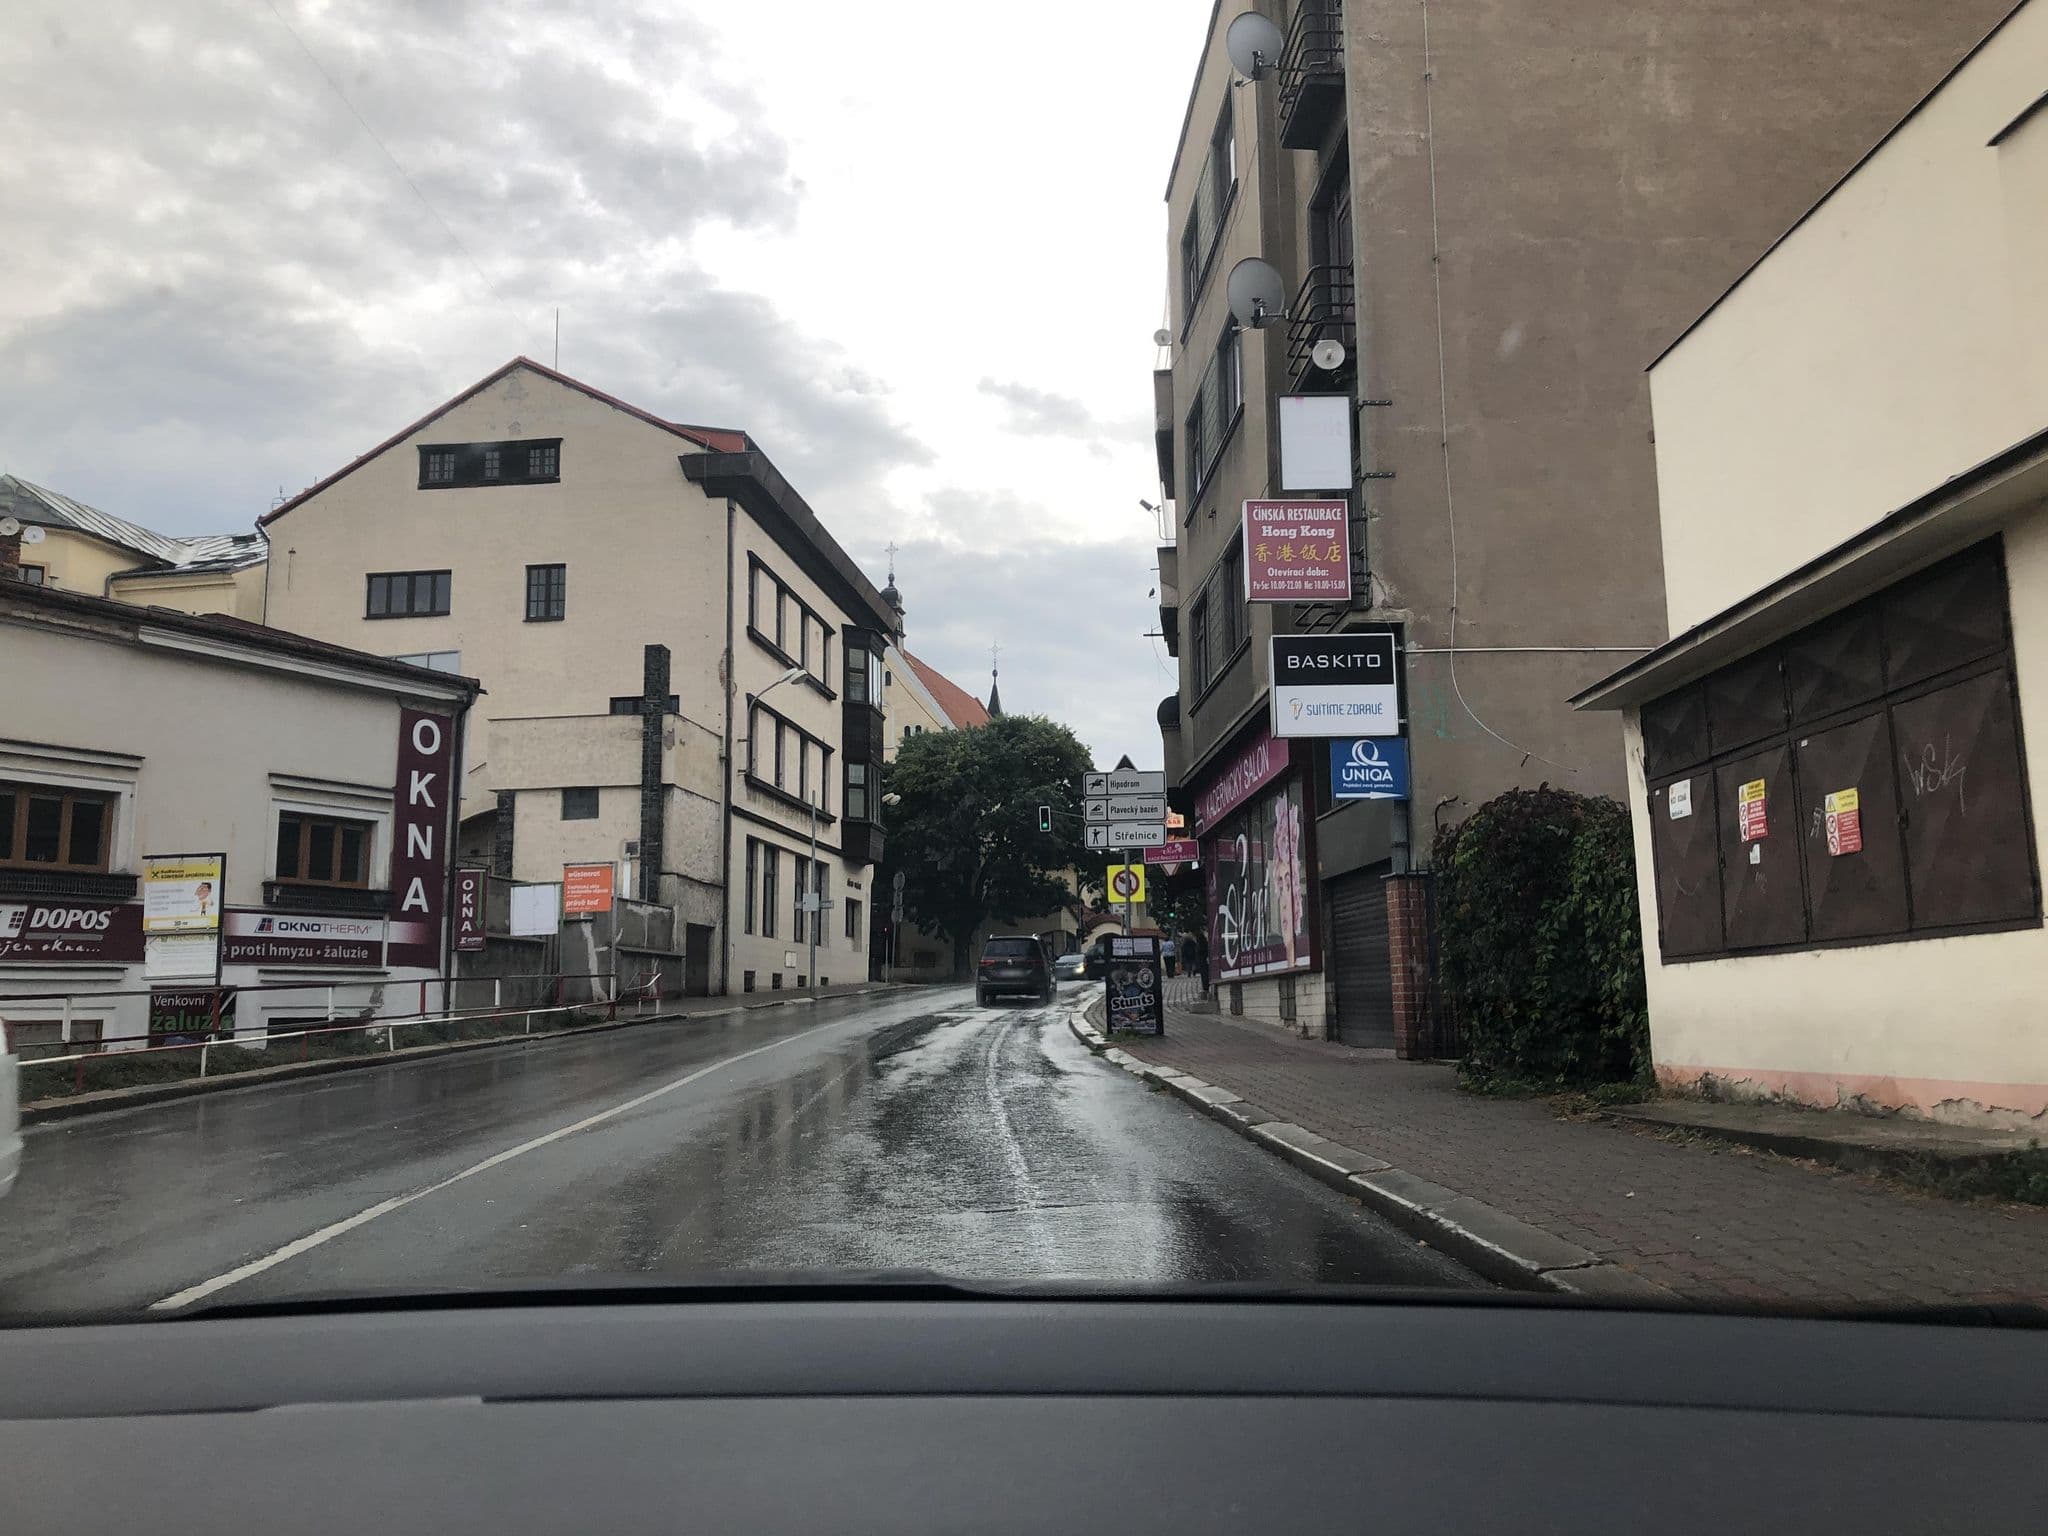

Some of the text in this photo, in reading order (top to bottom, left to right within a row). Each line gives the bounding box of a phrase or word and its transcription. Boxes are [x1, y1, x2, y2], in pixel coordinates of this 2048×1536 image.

[1253, 505, 1342, 521] ČÍNSKÁ RESTAURACE
[1261, 525, 1335, 539] Hong Kong
[1306, 566, 1329, 576] doba:
[1287, 654, 1381, 669] BASKITO
[1243, 739, 1270, 789] SALON
[1342, 769, 1393, 782] UNIQA
[1110, 780, 1140, 790] Hipodrom
[401, 718, 441, 913] OKNA
[1110, 804, 1159, 815] Plavecký bazén
[1115, 831, 1157, 841] Střelnice
[461, 879, 474, 932] OKNA
[30, 908, 112, 930] DOPOS
[278, 921, 370, 935] OKNOTHERM
[230, 943, 266, 959] proti
[269, 943, 313, 960] hmyzu
[323, 944, 369, 959] žaluzie
[153, 995, 206, 1007] Venkovní
[1111, 993, 1155, 1011] Stunts
